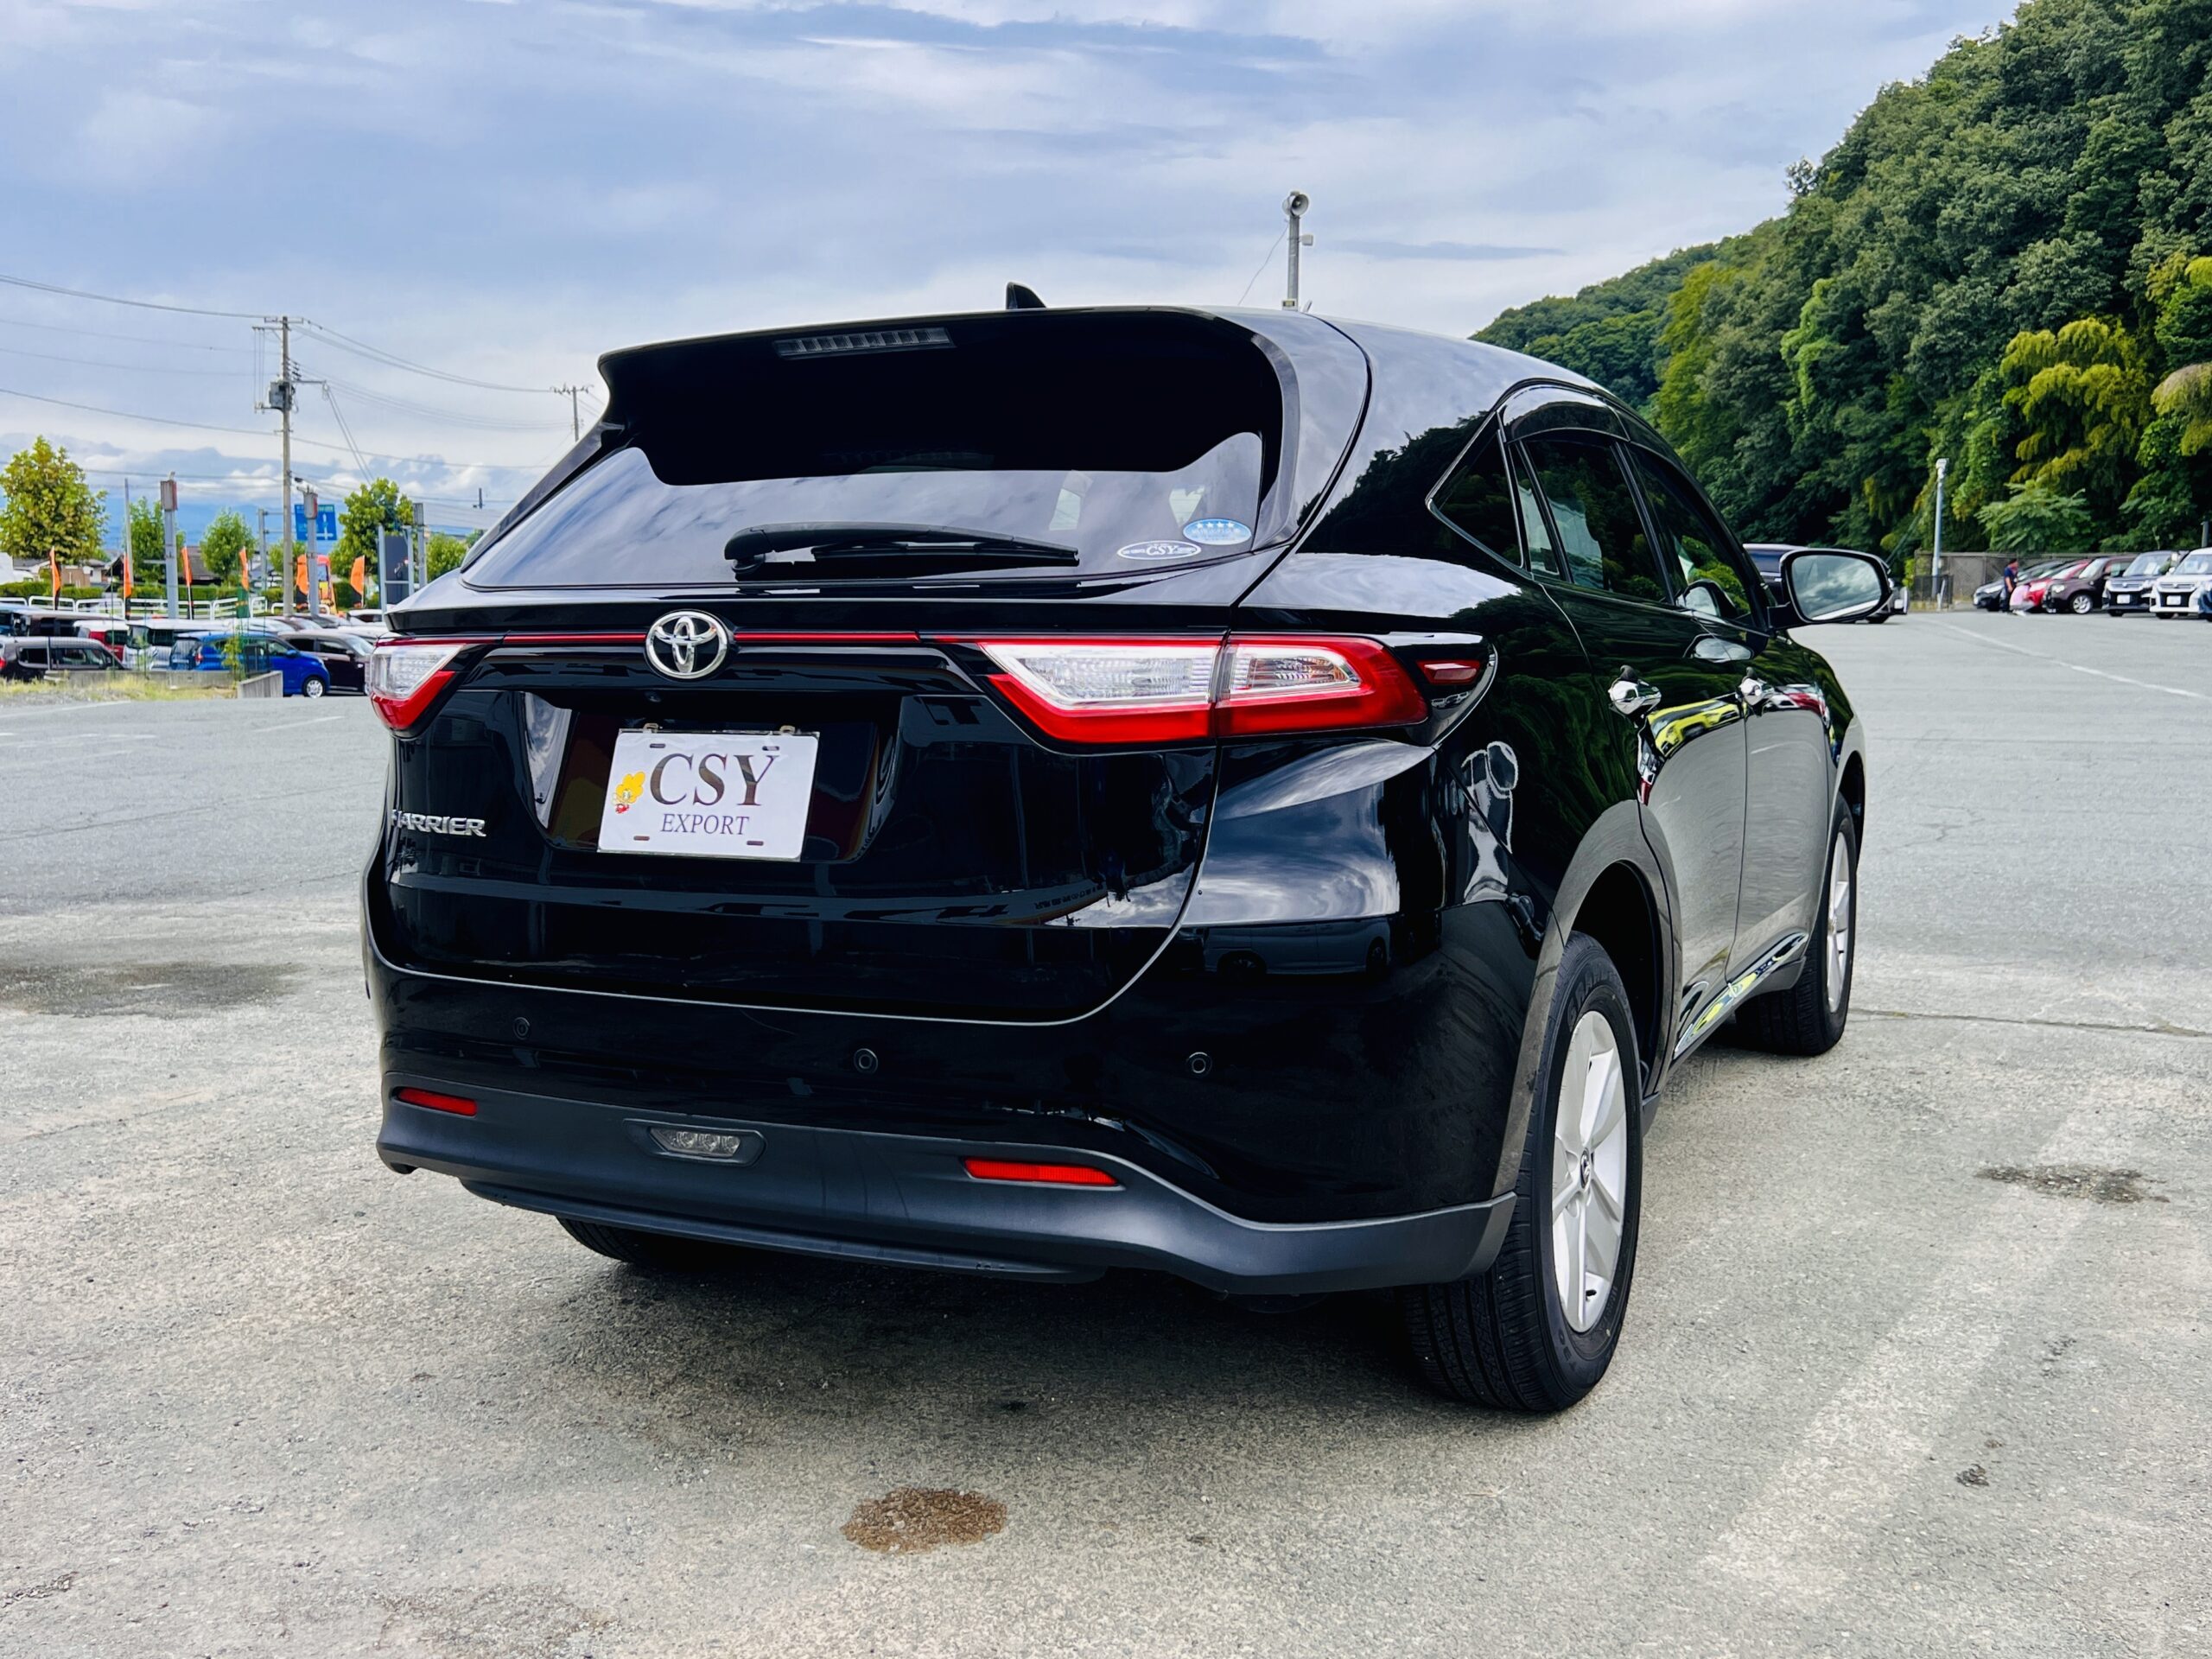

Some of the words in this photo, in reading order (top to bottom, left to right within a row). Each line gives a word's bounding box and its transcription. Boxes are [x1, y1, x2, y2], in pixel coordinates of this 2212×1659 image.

[1146, 545, 1180, 556] CSY
[650, 753, 779, 805] CSY
[660, 813, 749, 835] EXPORT
